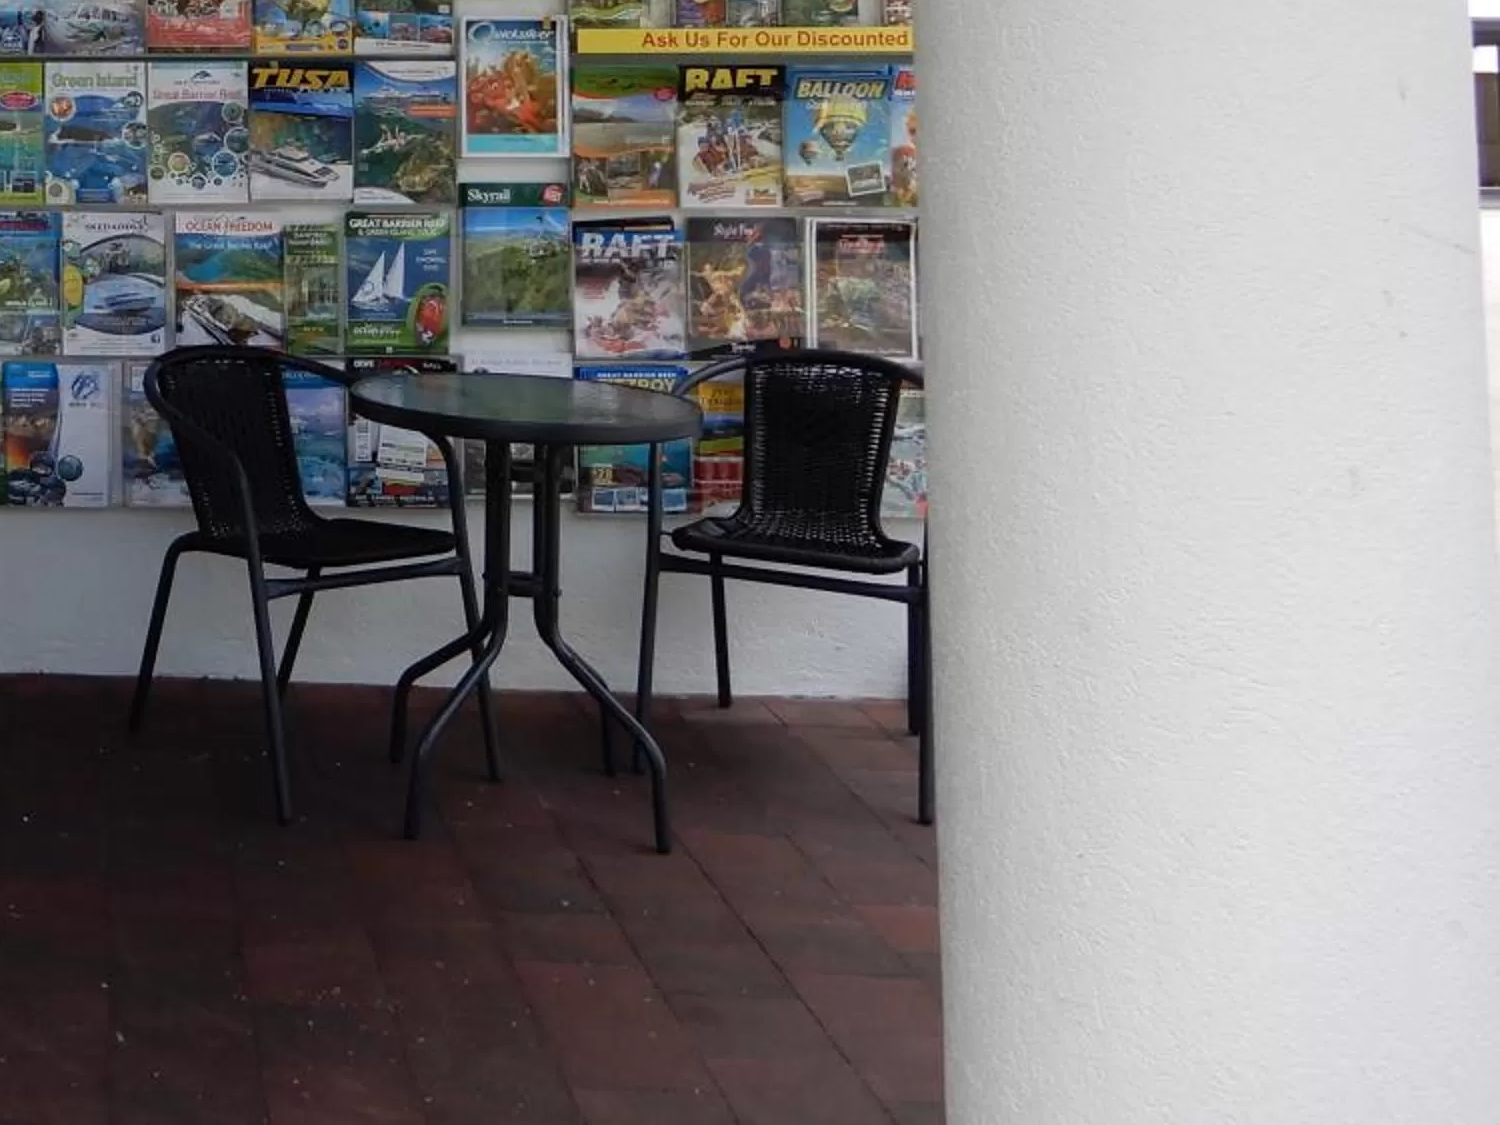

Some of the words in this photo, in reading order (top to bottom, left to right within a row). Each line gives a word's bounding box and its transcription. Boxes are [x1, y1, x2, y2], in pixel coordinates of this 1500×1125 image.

[642, 32, 678, 48] Ask
[685, 32, 710, 48] Us
[717, 31, 749, 48] For
[755, 30, 790, 47] Our
[797, 29, 909, 47] Discounted
[51, 72, 93, 88] Green
[96, 71, 137, 88] Island
[252, 66, 350, 90] TUSA
[685, 68, 778, 92] RAFT
[796, 79, 886, 99] BALLOON
[467, 188, 512, 204] Skyrail
[185, 221, 220, 232] OCEAN
[349, 218, 381, 229] GREAT
[382, 218, 423, 228] BARRIER
[581, 232, 675, 259] RAFT
